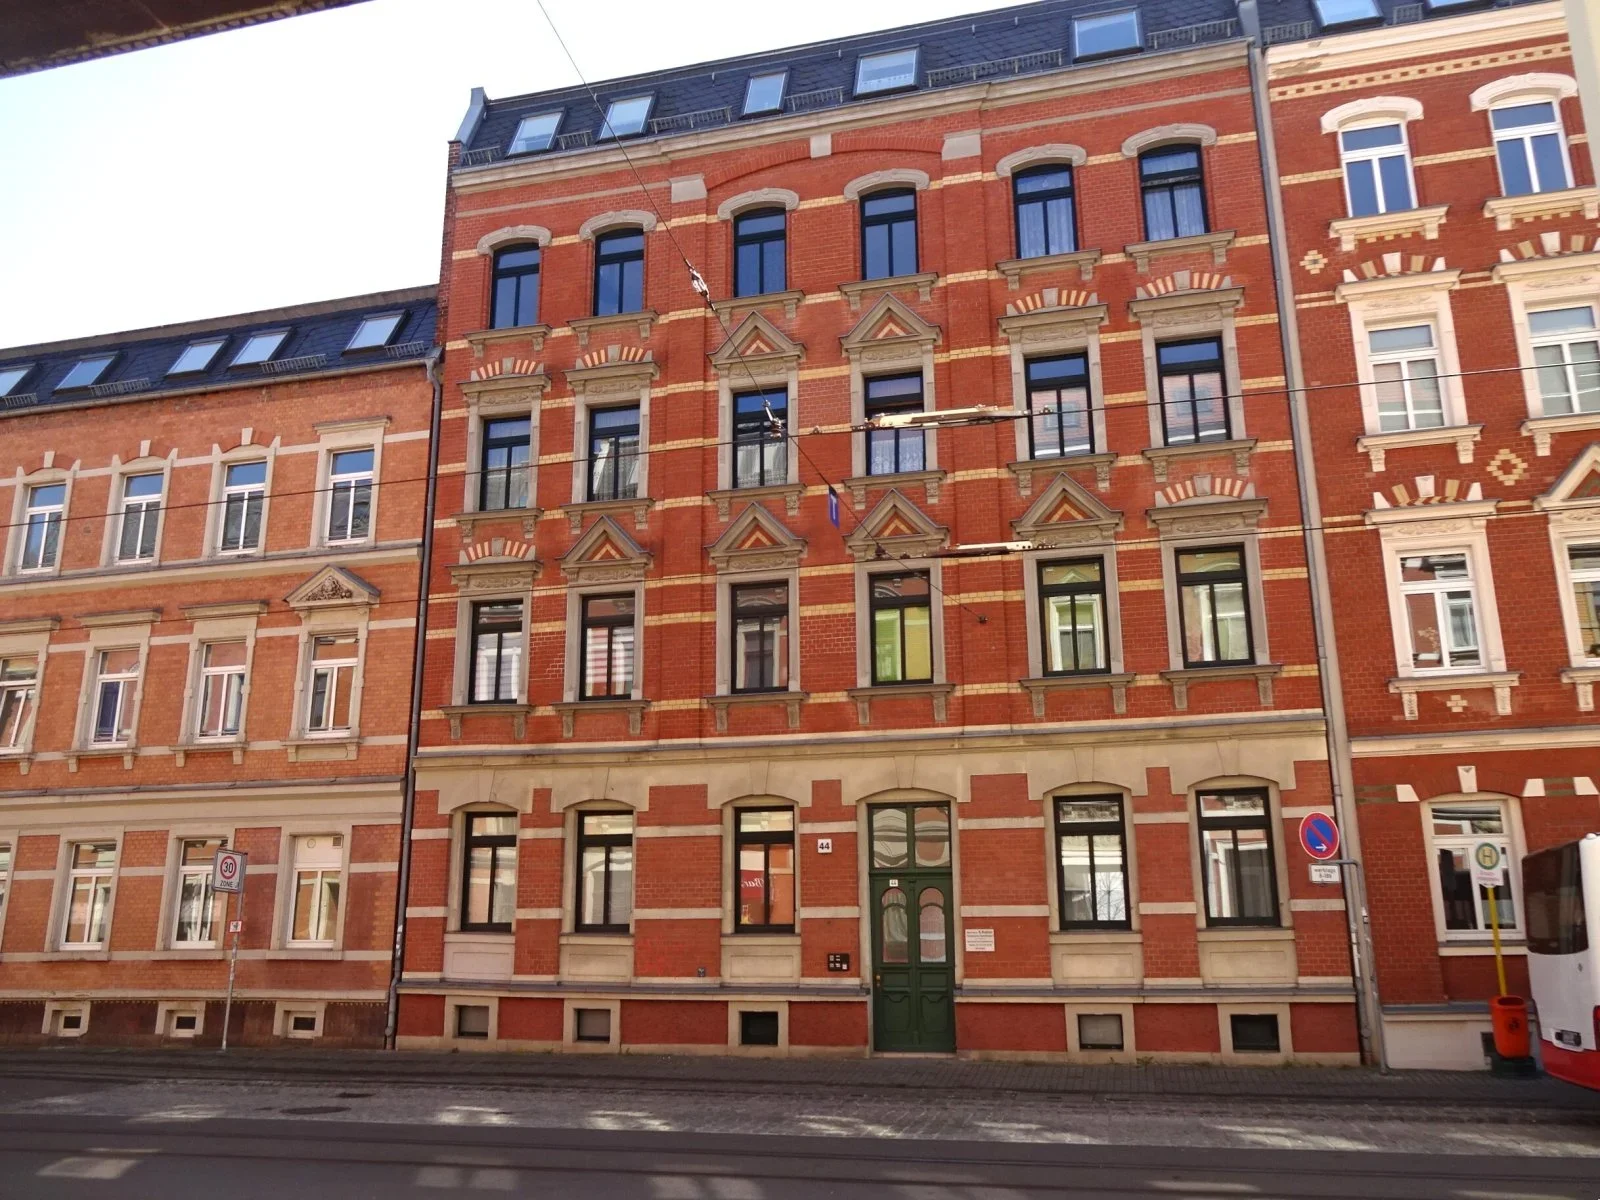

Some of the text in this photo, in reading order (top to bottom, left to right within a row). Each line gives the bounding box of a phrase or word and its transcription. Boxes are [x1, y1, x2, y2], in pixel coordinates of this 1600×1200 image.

[818, 842, 830, 850] 44
[1482, 848, 1492, 864] H
[223, 861, 234, 873] 30
[220, 880, 233, 888] ZONE
